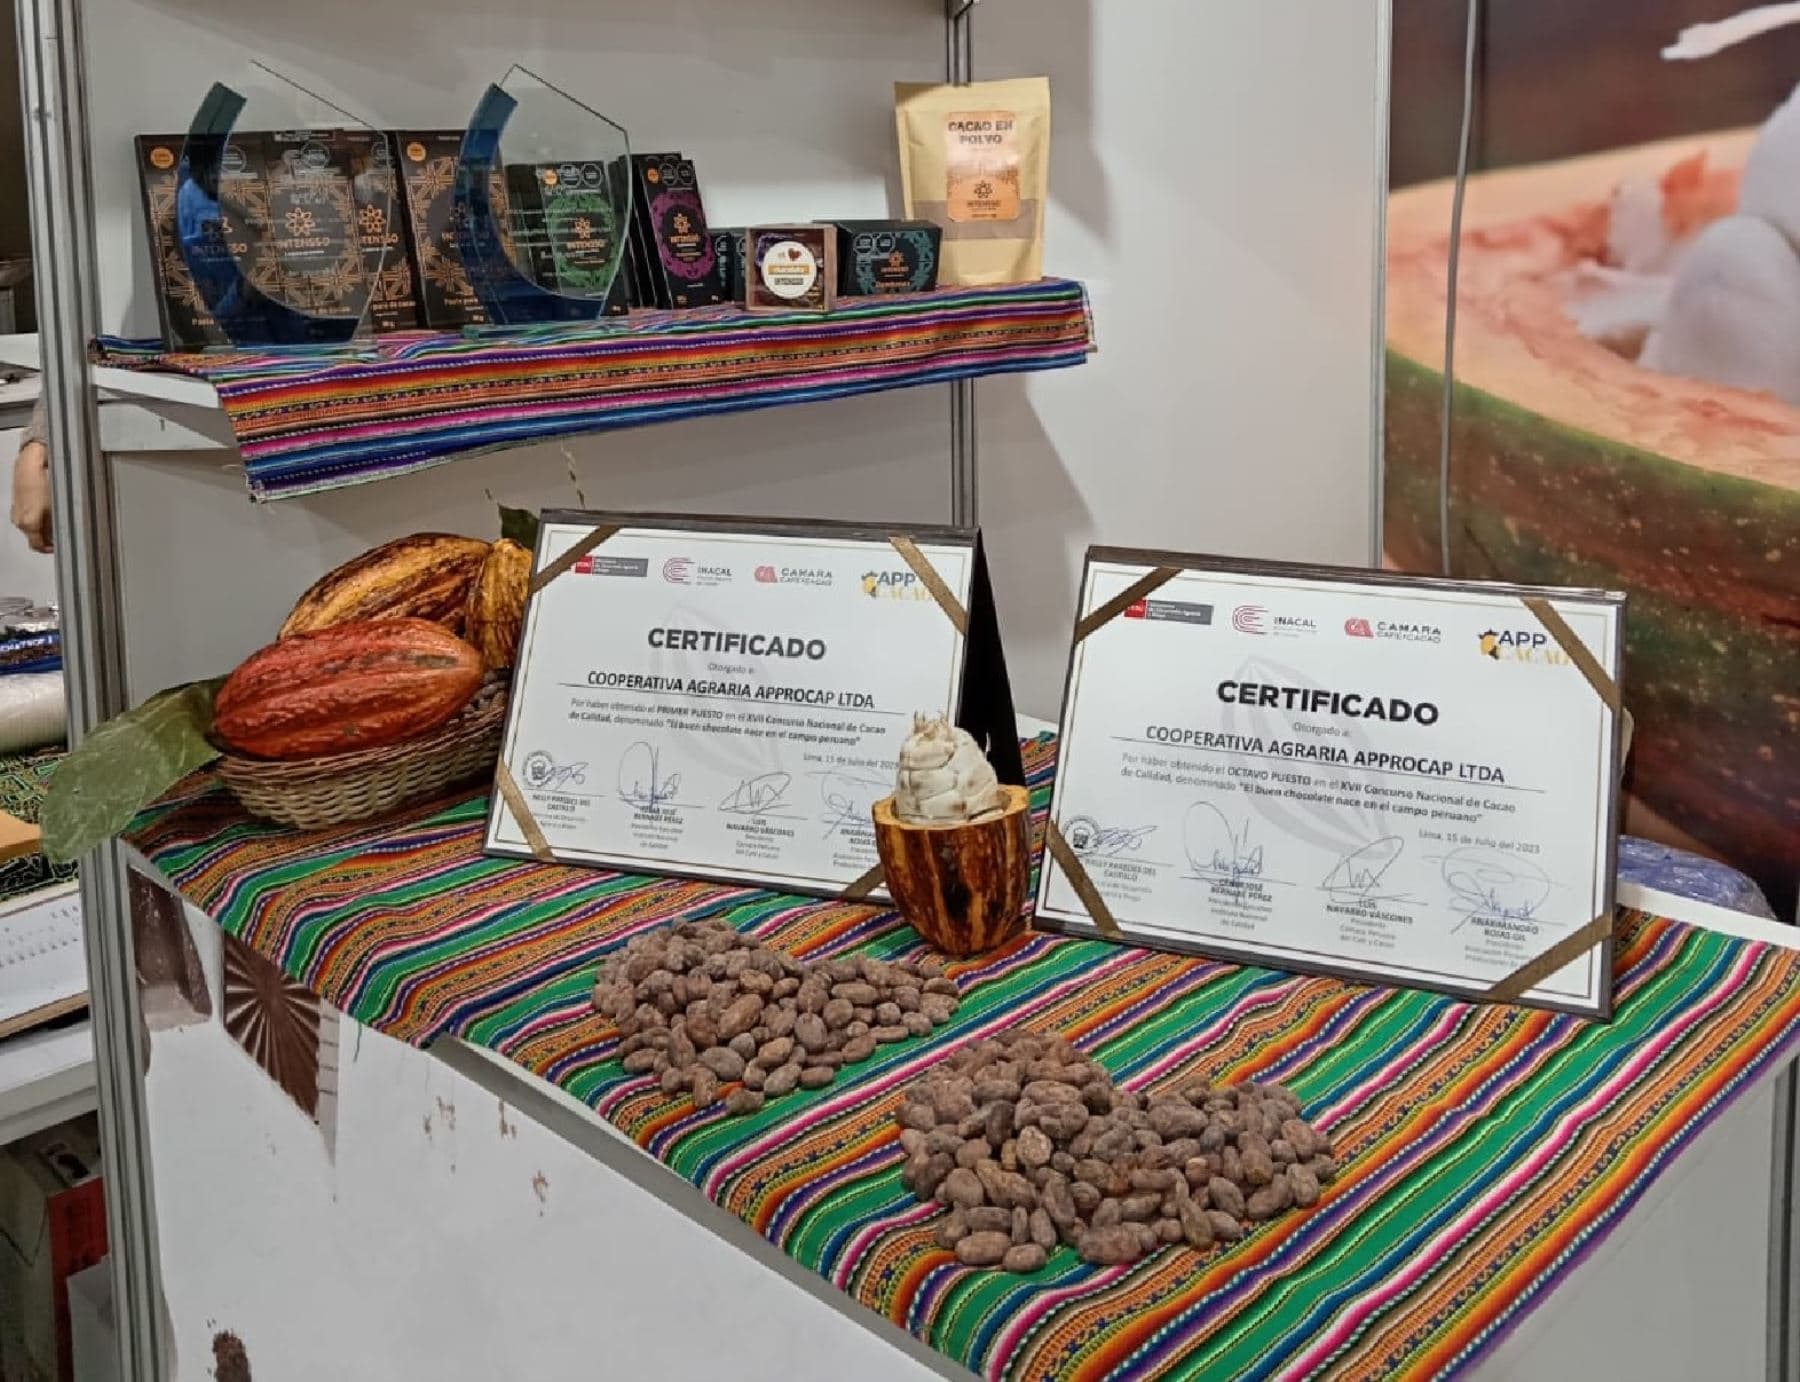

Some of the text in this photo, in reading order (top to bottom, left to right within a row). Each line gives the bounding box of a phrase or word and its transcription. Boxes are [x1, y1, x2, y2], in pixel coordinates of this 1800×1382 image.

[948, 120, 1013, 132] CACAO EN
[960, 134, 1002, 144] POLVO
[878, 571, 916, 587] APP
[1273, 616, 1317, 628] INACAL
[1377, 621, 1442, 636] CAMARA
[648, 628, 826, 660] CERTIFICADO
[1499, 630, 1548, 649] APP
[588, 670, 875, 709] COOPERATIVA AGRARIA APPROCAP LTDA
[1217, 680, 1439, 727] CERTIFICADO
[657, 705, 689, 715] PRIMER
[691, 708, 723, 720] PUESTO
[807, 719, 846, 732] Nacional
[1292, 721, 1342, 737] Otorgado
[1146, 725, 1505, 783] COOPERATIVA AGRARIA APPROCAP LTDA
[1121, 766, 1133, 777] de
[1135, 768, 1172, 784] Calidad,
[1176, 774, 1236, 791] denominado
[1255, 784, 1282, 797] buen
[1284, 788, 1334, 804] chocolate
[1336, 796, 1361, 807] nace
[1363, 800, 1378, 809] en
[1379, 800, 1390, 811] el
[1392, 804, 1429, 817] campo
[1141, 755, 1168, 768] haber
[1170, 759, 1215, 774] obtenido
[1227, 766, 1268, 780] OCTAVO
[1271, 771, 1312, 786] PUESTO
[1329, 780, 1339, 790] el
[1340, 779, 1362, 791] XVII
[1364, 783, 1413, 800] Concurso
[1416, 790, 1464, 806] Nacional
[1466, 796, 1480, 808] de
[1483, 799, 1516, 814] Cacao
[1446, 832, 1458, 842] 15
[1460, 834, 1473, 844] de
[1499, 839, 1514, 851] del
[1516, 842, 1540, 854] 2023
